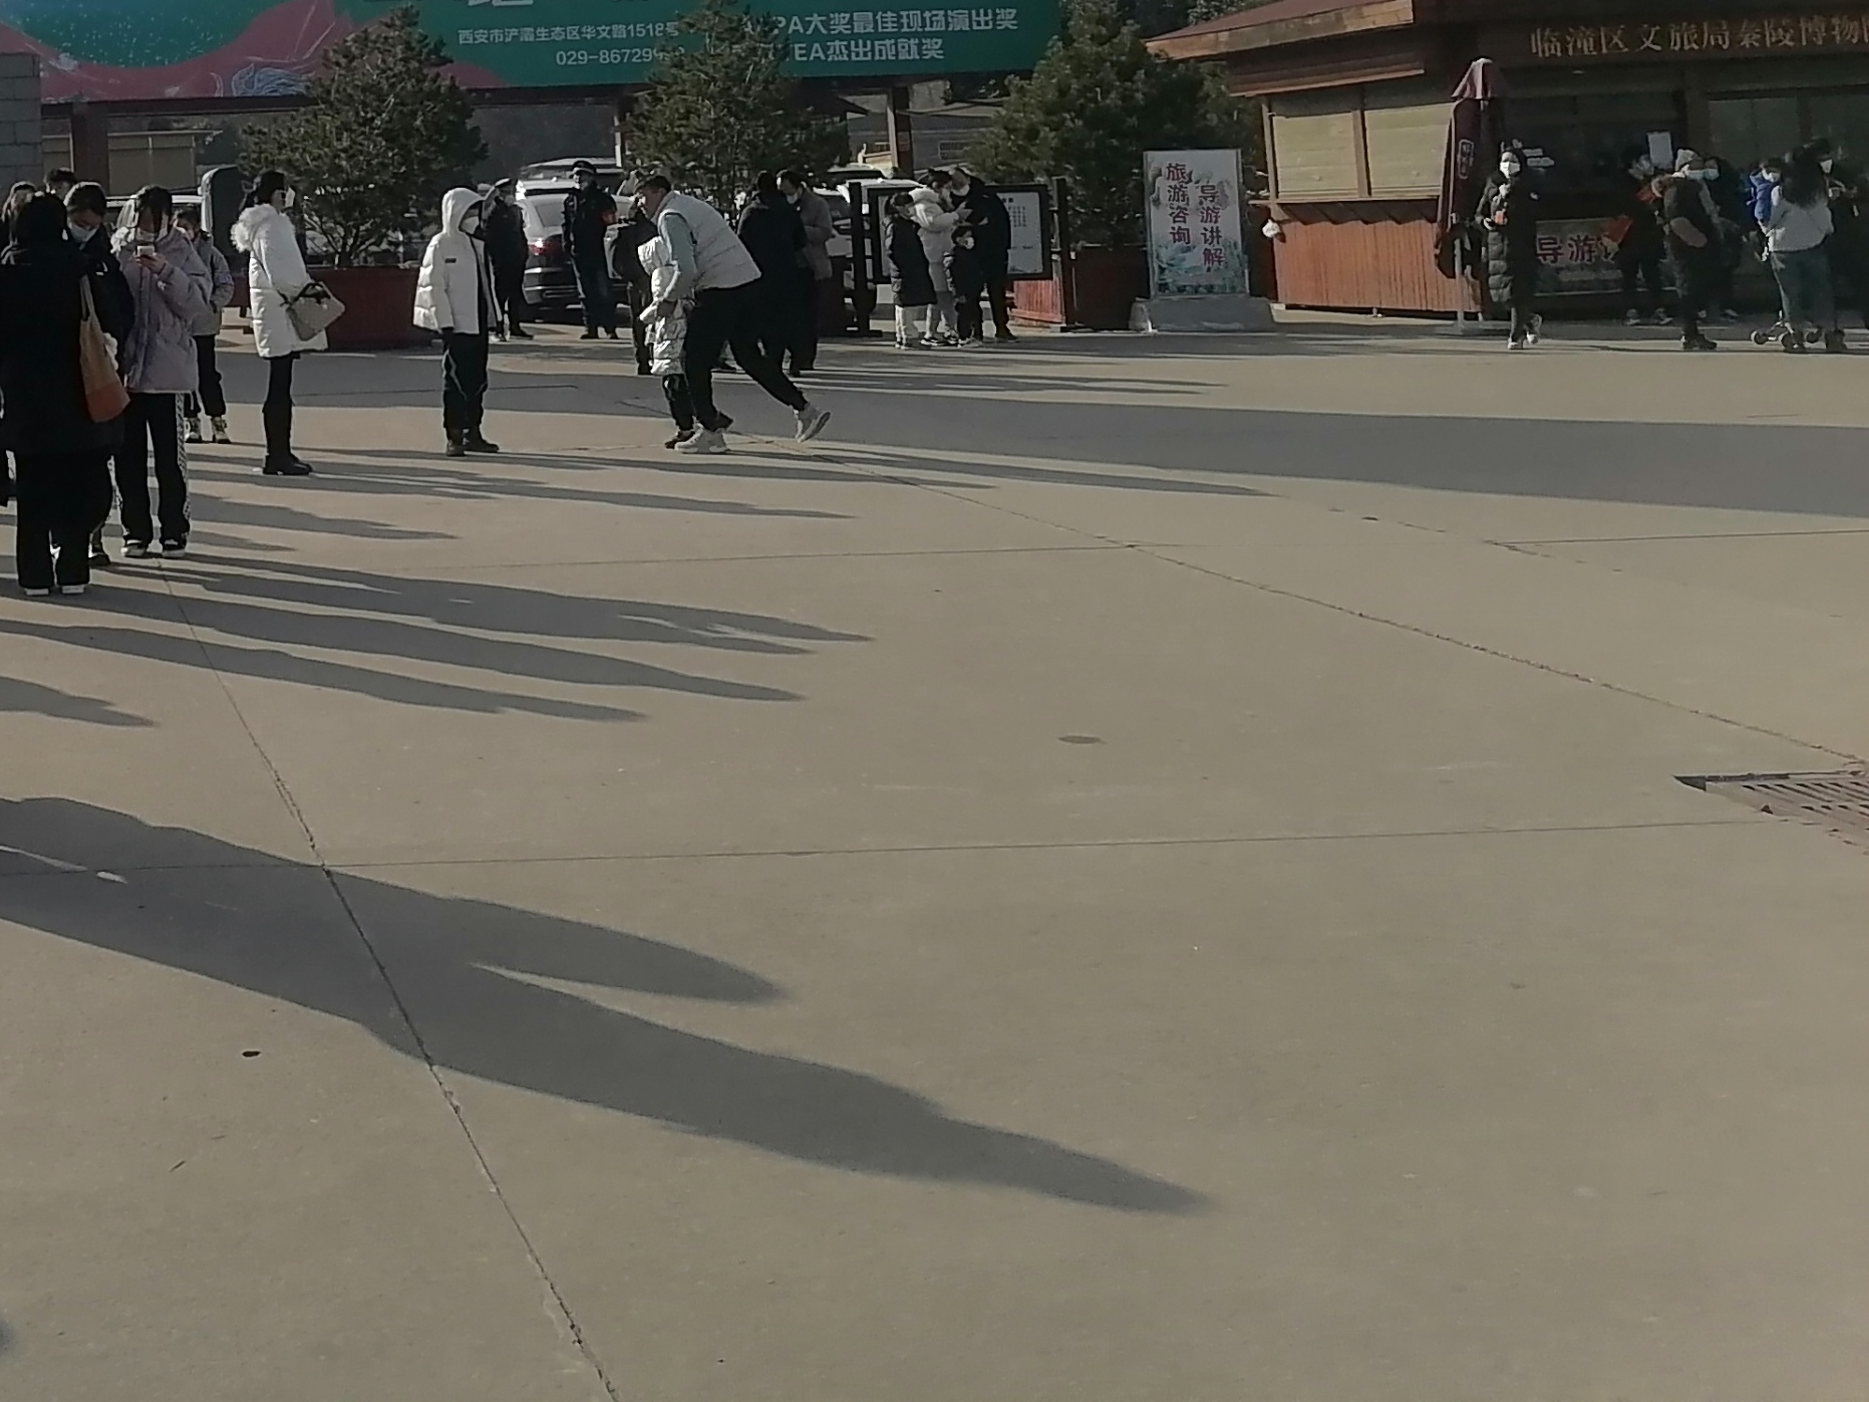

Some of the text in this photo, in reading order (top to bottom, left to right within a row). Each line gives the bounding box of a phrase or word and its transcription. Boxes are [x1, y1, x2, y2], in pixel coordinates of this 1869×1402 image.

[771, 8, 1018, 34] PA大奖最佳现场演出奖
[1531, 14, 1869, 58] 临潼区文旅局秦陵博物
[787, 37, 945, 62] EA杰出成就奖
[1166, 163, 1191, 245] 旅游咨询
[1198, 185, 1225, 267] 导游讲解
